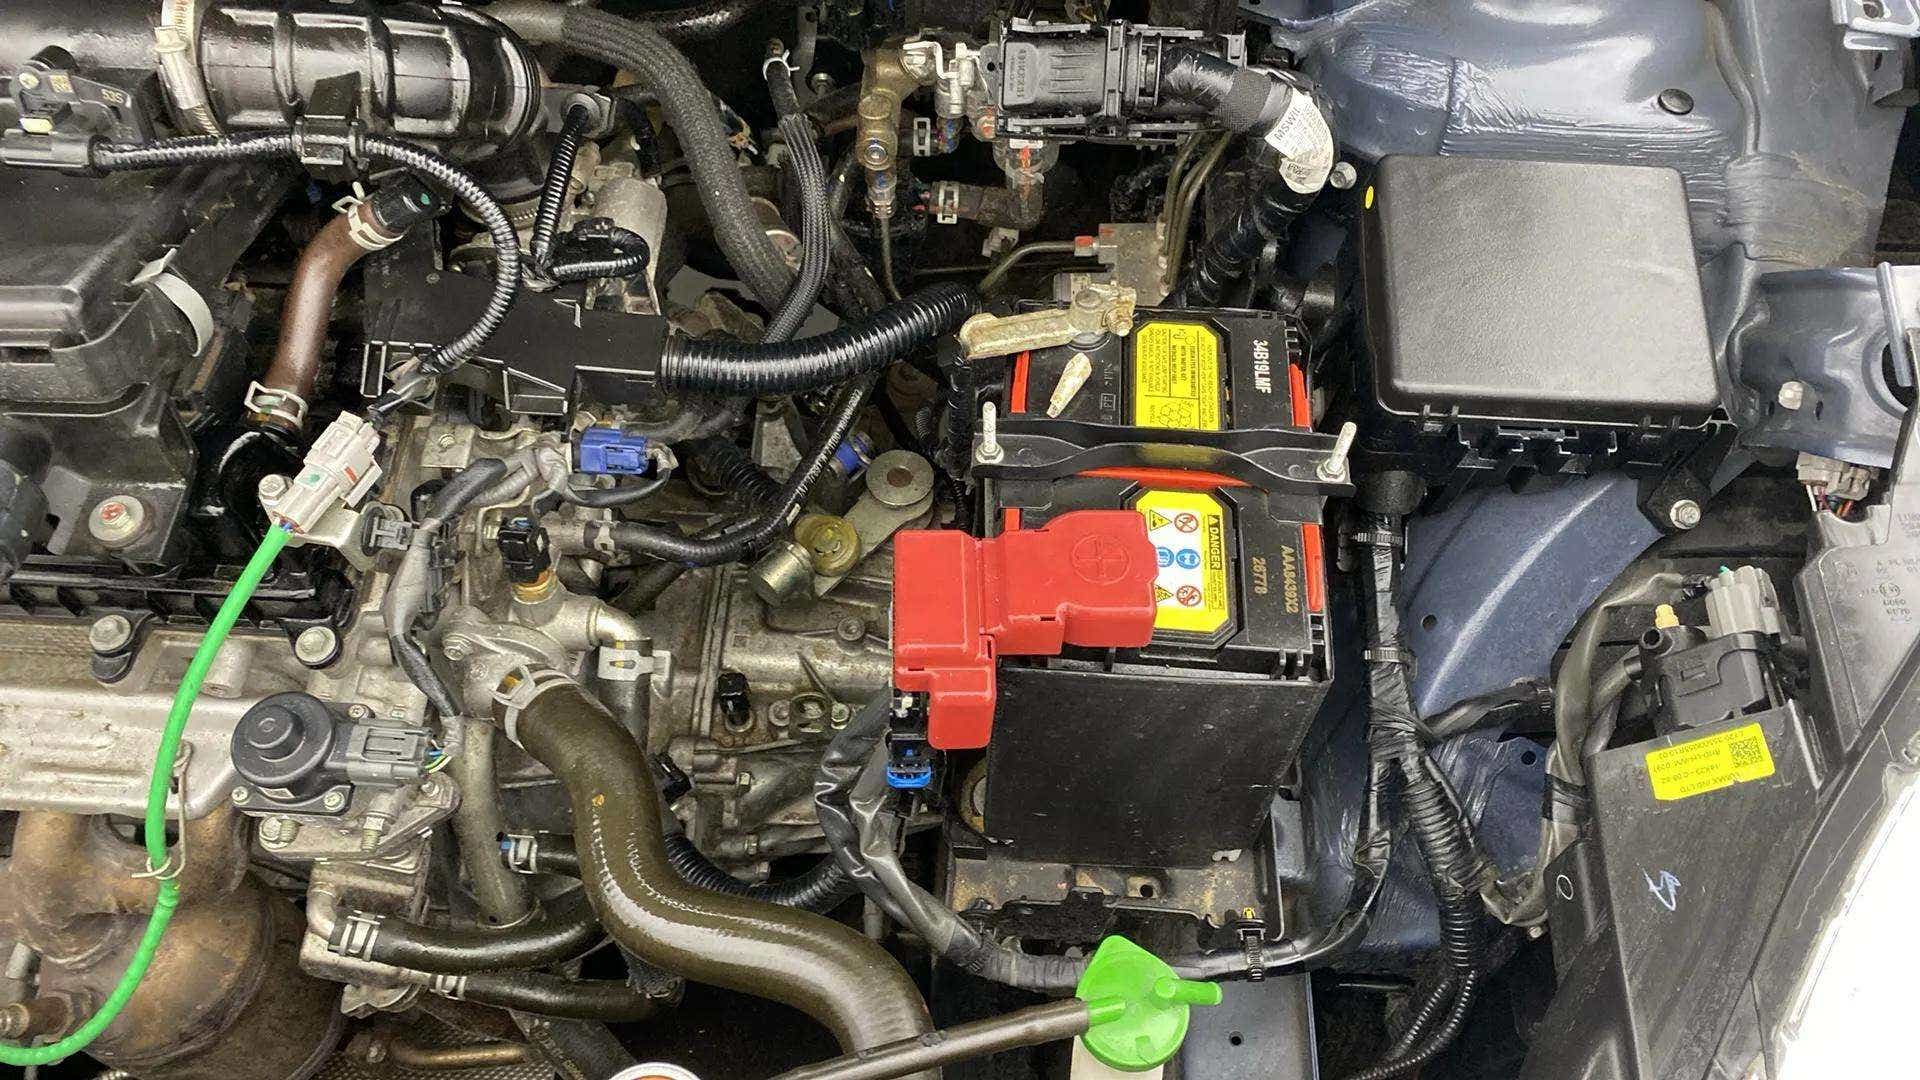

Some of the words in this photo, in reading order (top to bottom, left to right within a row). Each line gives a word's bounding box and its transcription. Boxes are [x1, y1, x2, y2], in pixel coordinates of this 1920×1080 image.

[1252, 339, 1272, 394] 34B19LMF
[1209, 526, 1221, 570] DANGER
[1280, 545, 1299, 614] AAA8439X2
